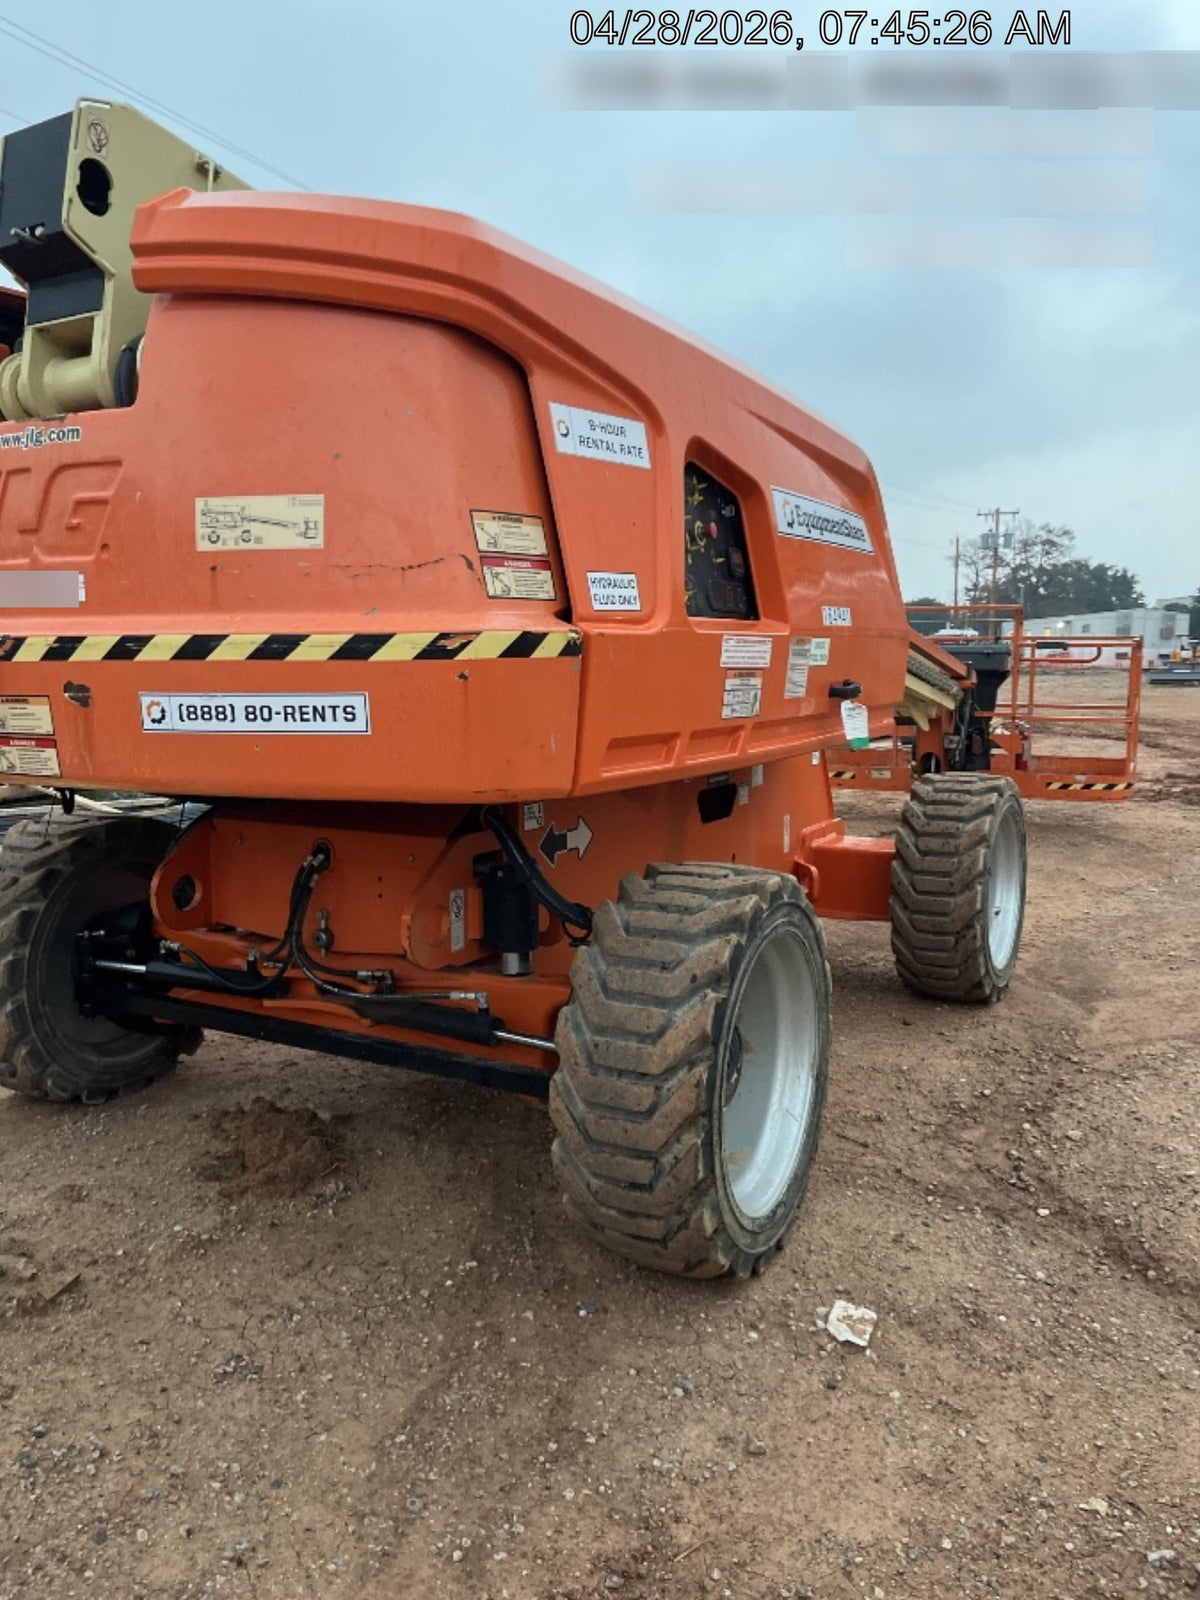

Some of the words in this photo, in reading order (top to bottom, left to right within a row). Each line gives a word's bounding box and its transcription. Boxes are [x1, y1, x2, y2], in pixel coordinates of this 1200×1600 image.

[579, 435, 617, 454] RENTAL
[620, 443, 644, 460] RATE
[590, 576, 636, 590] HYDRAULIC
[593, 593, 617, 606] FLUID
[178, 703, 236, 723] (888)
[244, 704, 357, 723] 80-RENTS
